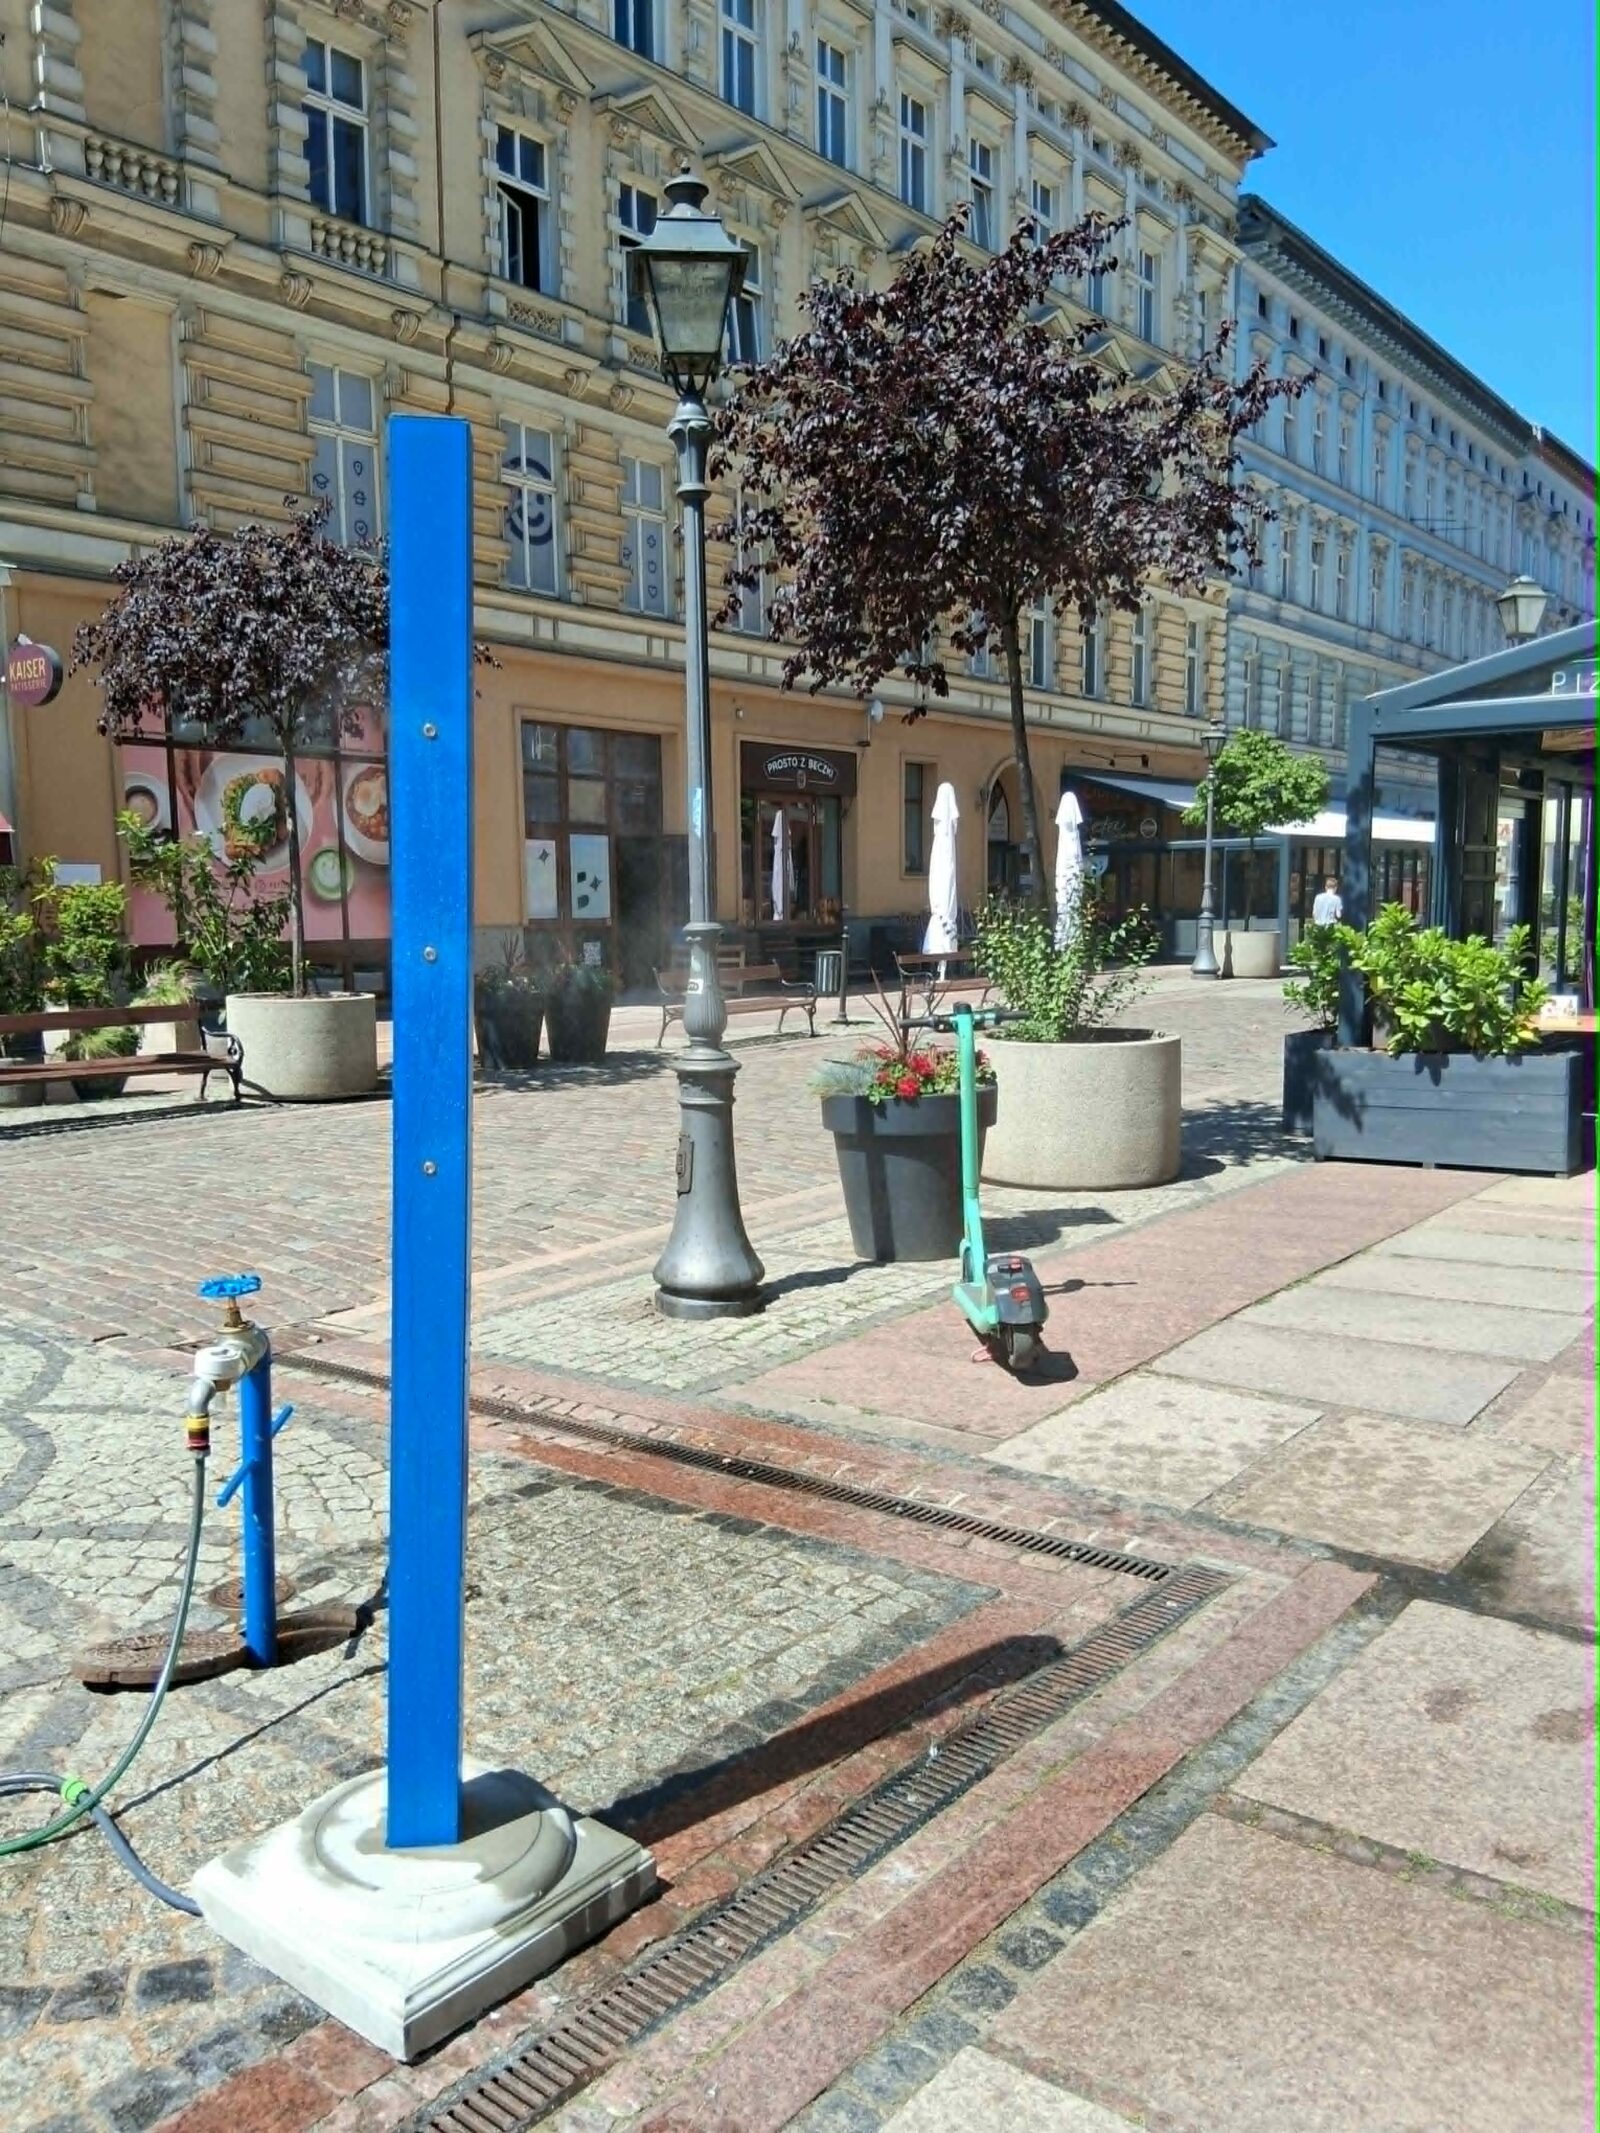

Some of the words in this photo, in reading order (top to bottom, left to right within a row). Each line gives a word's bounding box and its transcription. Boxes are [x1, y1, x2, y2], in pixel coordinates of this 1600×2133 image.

[9, 657, 46, 681] KAISER
[10, 679, 47, 691] PATISSERIE
[767, 756, 798, 773] PROSTO
[800, 757, 806, 768] Z
[808, 758, 834, 778] BECZKI
